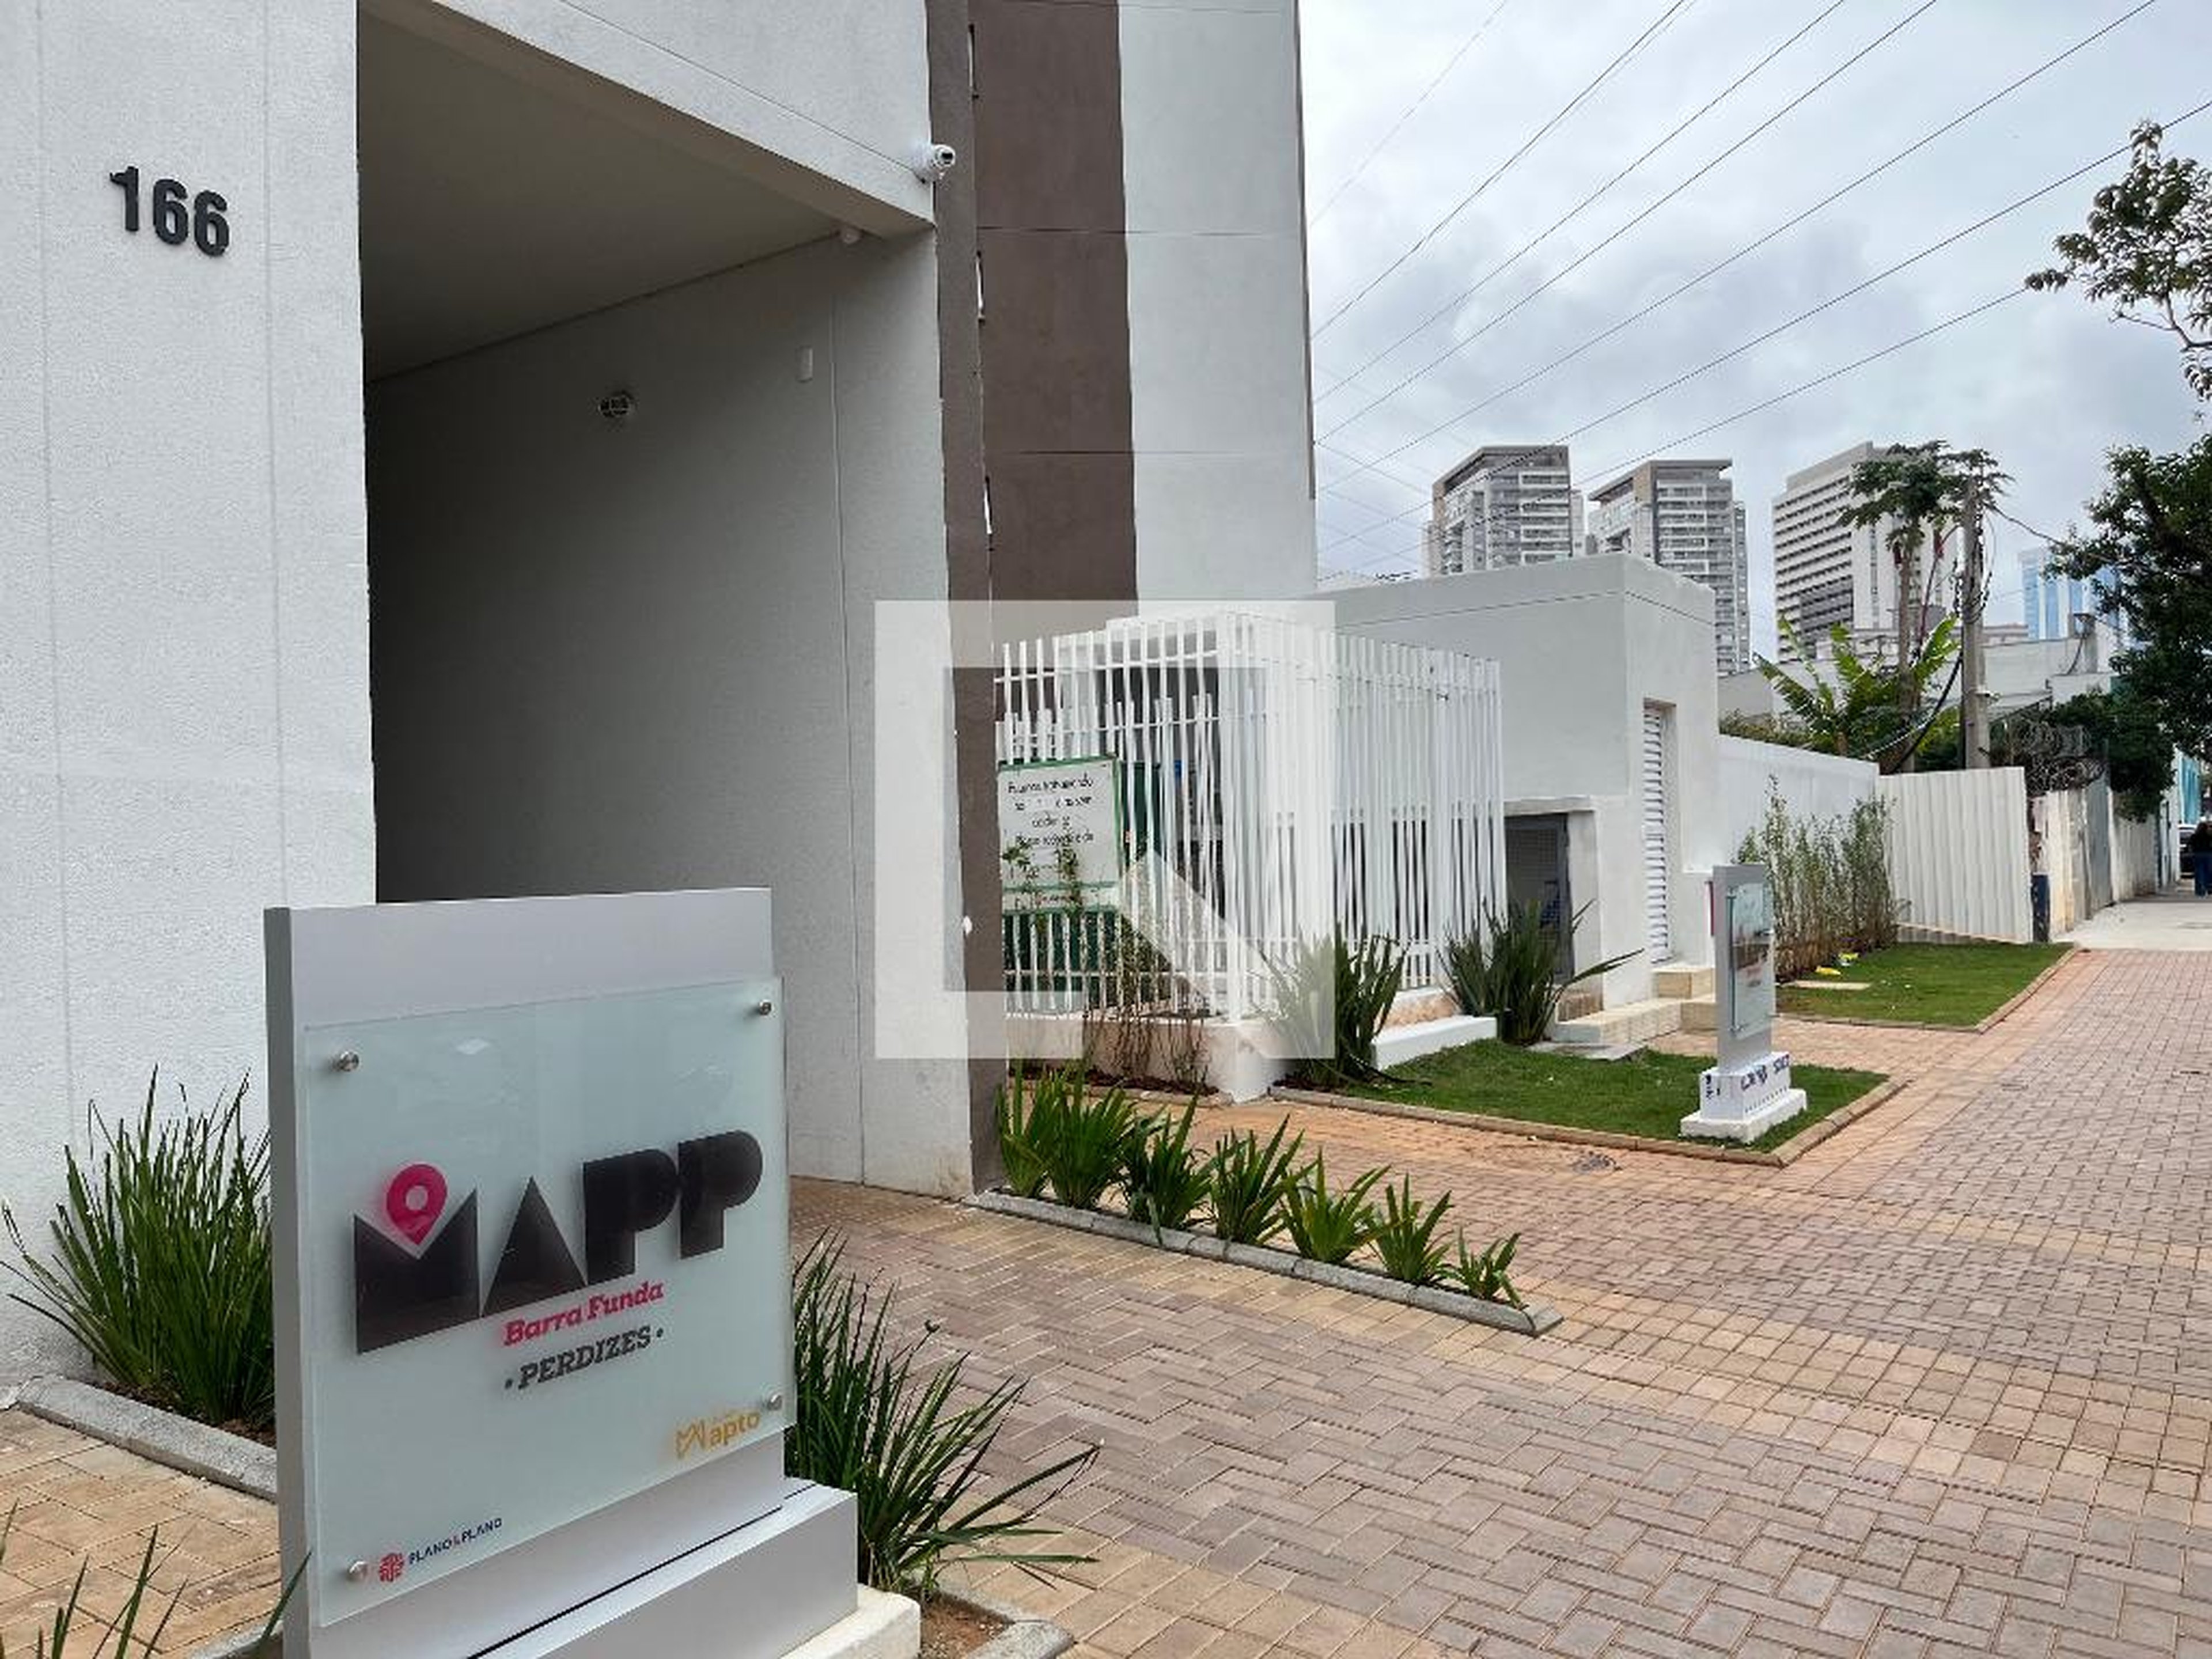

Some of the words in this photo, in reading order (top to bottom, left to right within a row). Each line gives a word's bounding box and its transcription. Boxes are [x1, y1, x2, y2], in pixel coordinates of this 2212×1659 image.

[109, 165, 230, 257] 166
[354, 1130, 763, 1355] MAPP
[504, 1306, 582, 1346] Barra
[587, 1281, 664, 1320] Funda
[518, 1325, 652, 1390] PERDIZES
